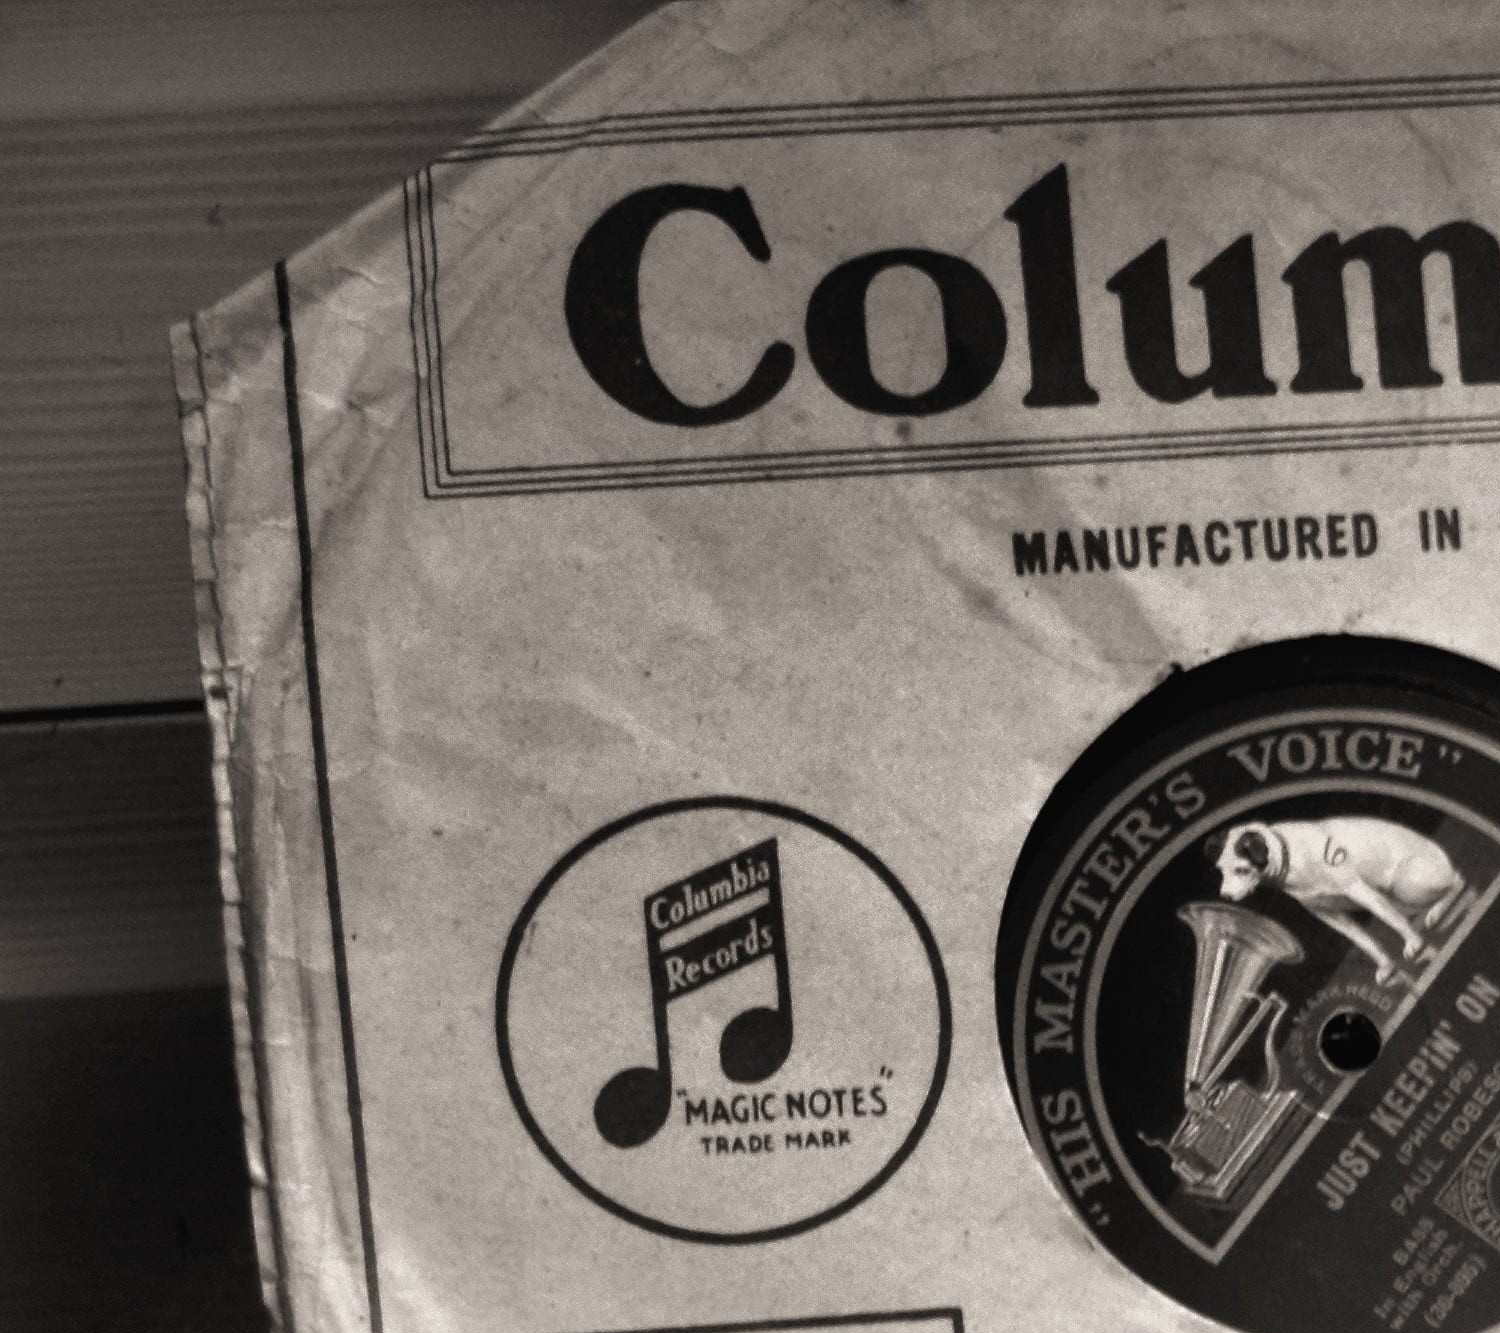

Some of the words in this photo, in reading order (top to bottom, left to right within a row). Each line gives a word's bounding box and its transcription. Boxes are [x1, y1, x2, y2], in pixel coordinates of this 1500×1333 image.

[1012, 512, 1380, 578] MANUFACTURED
[1417, 507, 1463, 553] IN
[650, 858, 771, 932] Columbia
[1034, 773, 1207, 1054] MASTER'S
[666, 921, 775, 994] Records
[701, 1134, 777, 1155] TRADE
[785, 1127, 852, 1151] MARK
[1310, 1129, 1386, 1214] JUST
[1367, 1017, 1470, 1138] KEEPIN'
[1389, 1150, 1446, 1217] PAUL
